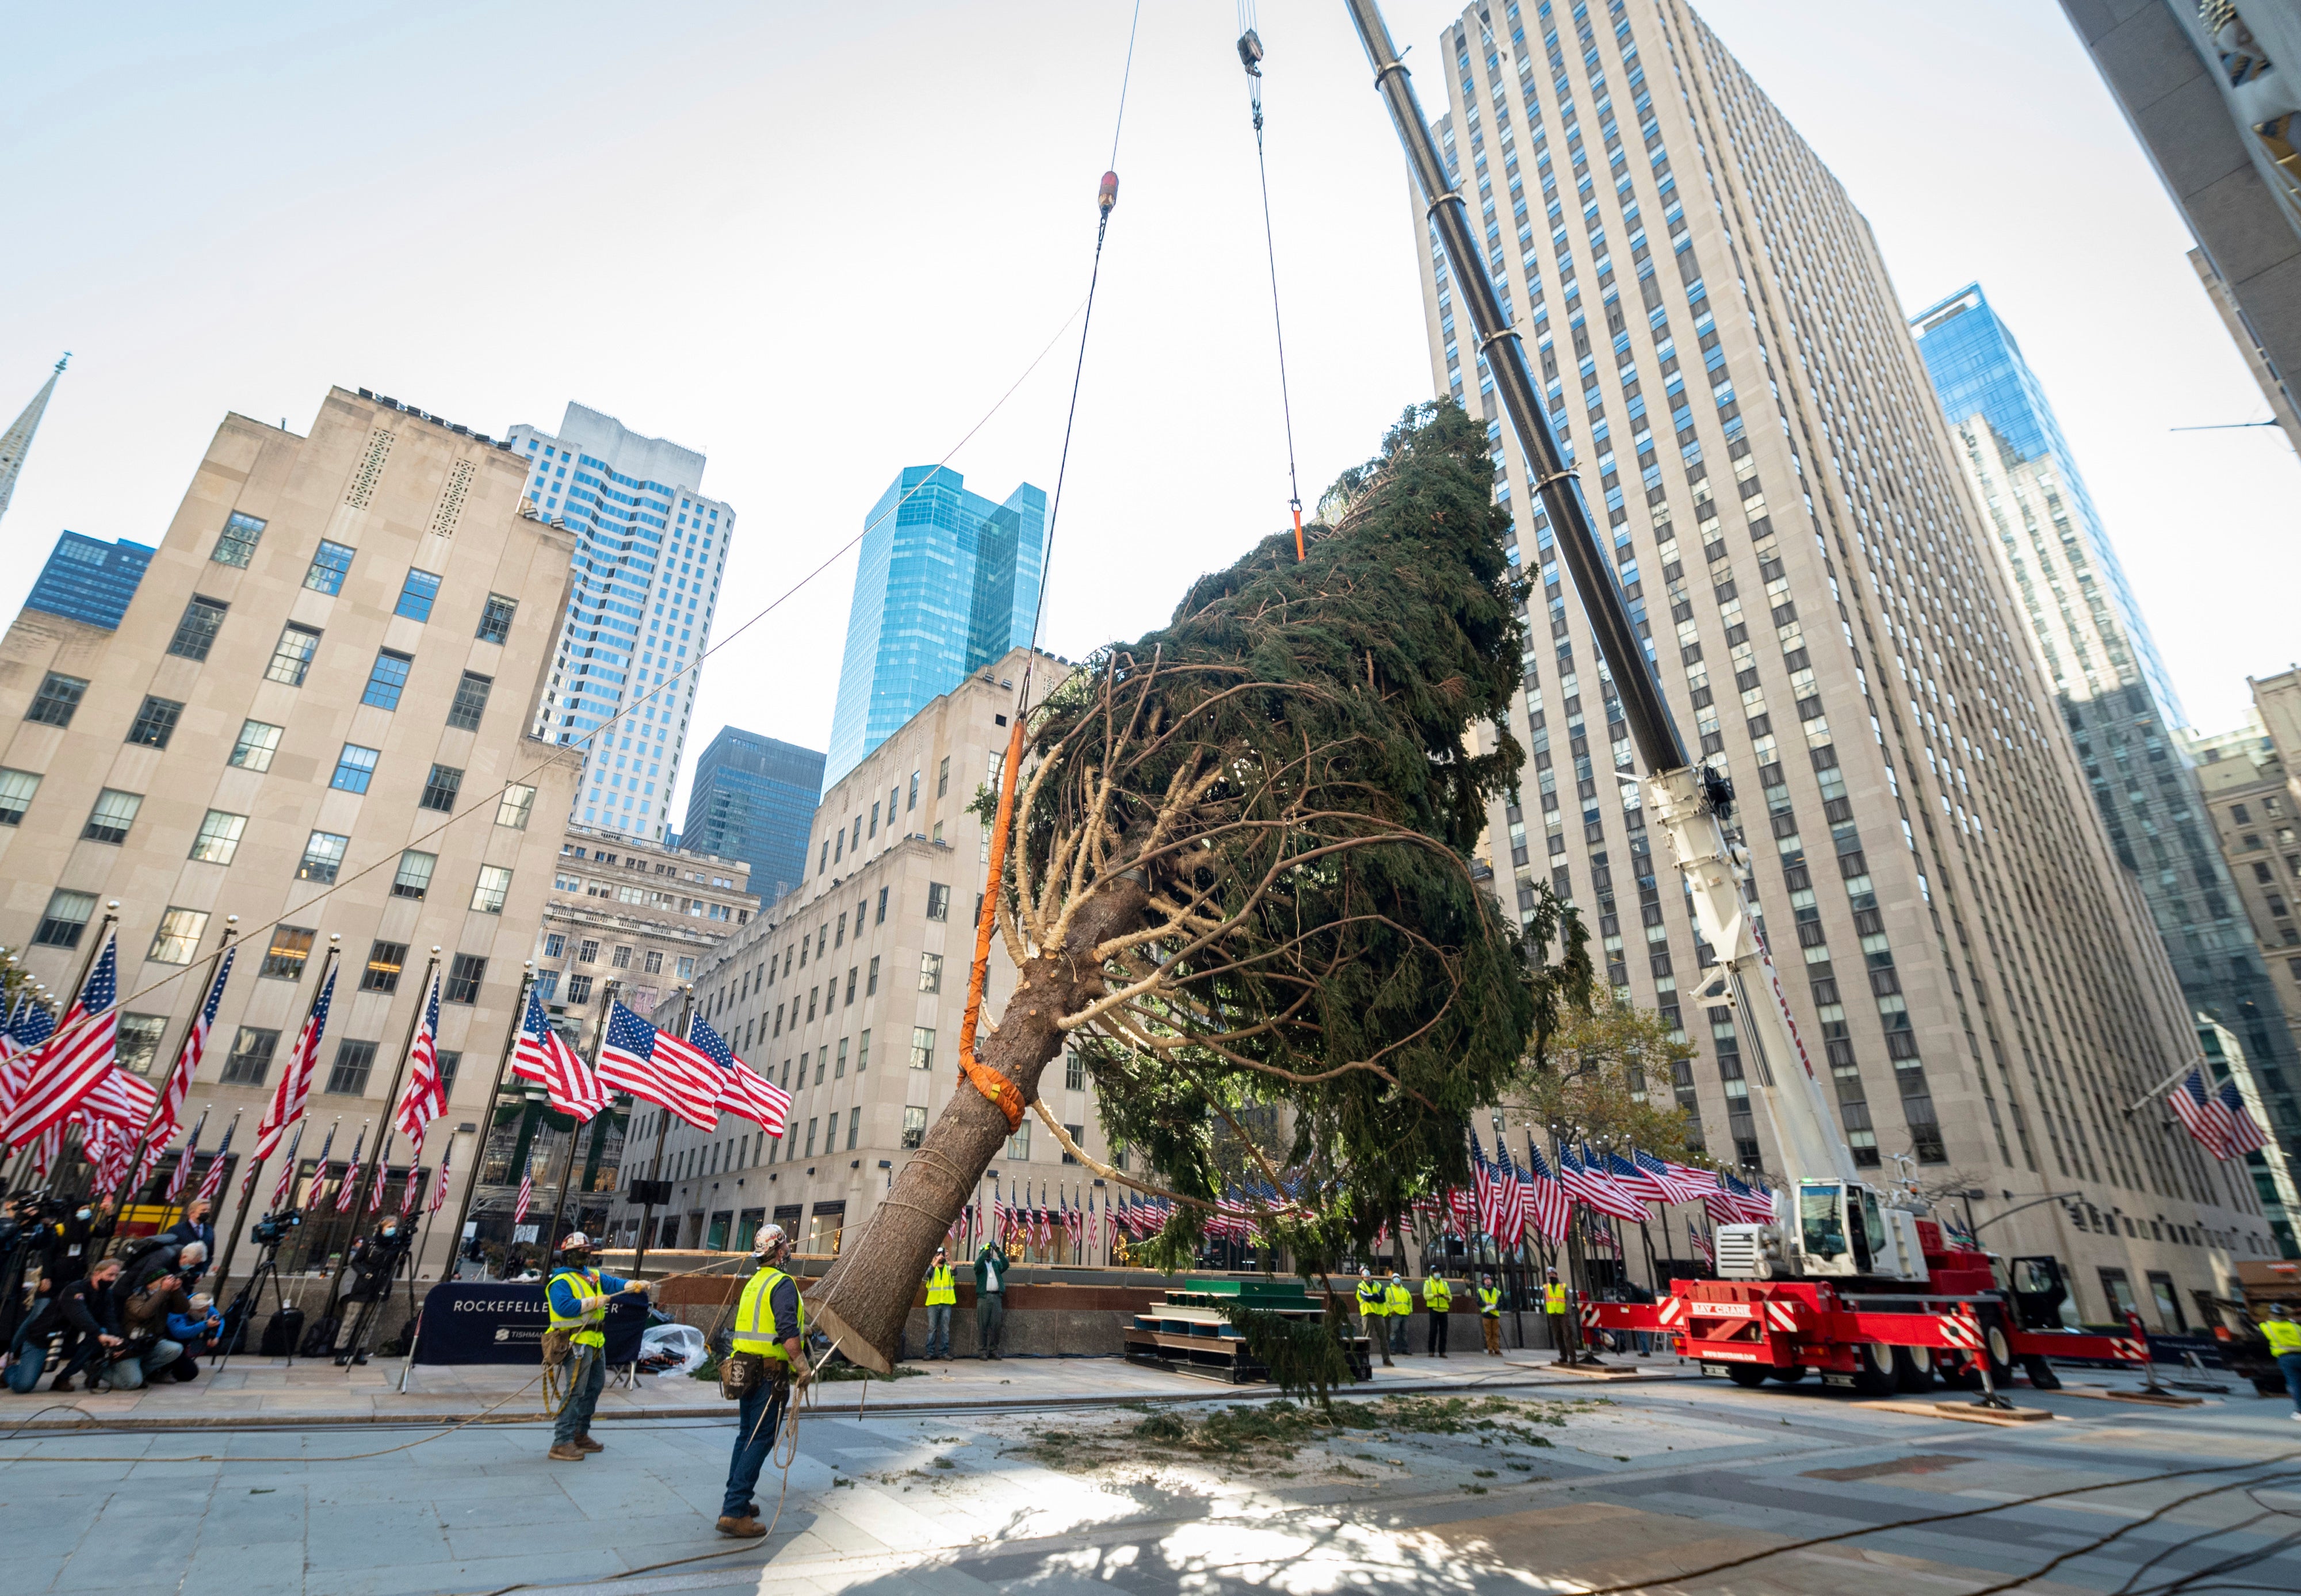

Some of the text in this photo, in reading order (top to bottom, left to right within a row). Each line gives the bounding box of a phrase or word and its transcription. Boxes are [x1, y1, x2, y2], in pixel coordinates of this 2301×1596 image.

[1773, 976, 1814, 1080] CRANE
[453, 1300, 549, 1312] ROCKEFELLE
[1693, 1304, 1750, 1315] BAY CRANE
